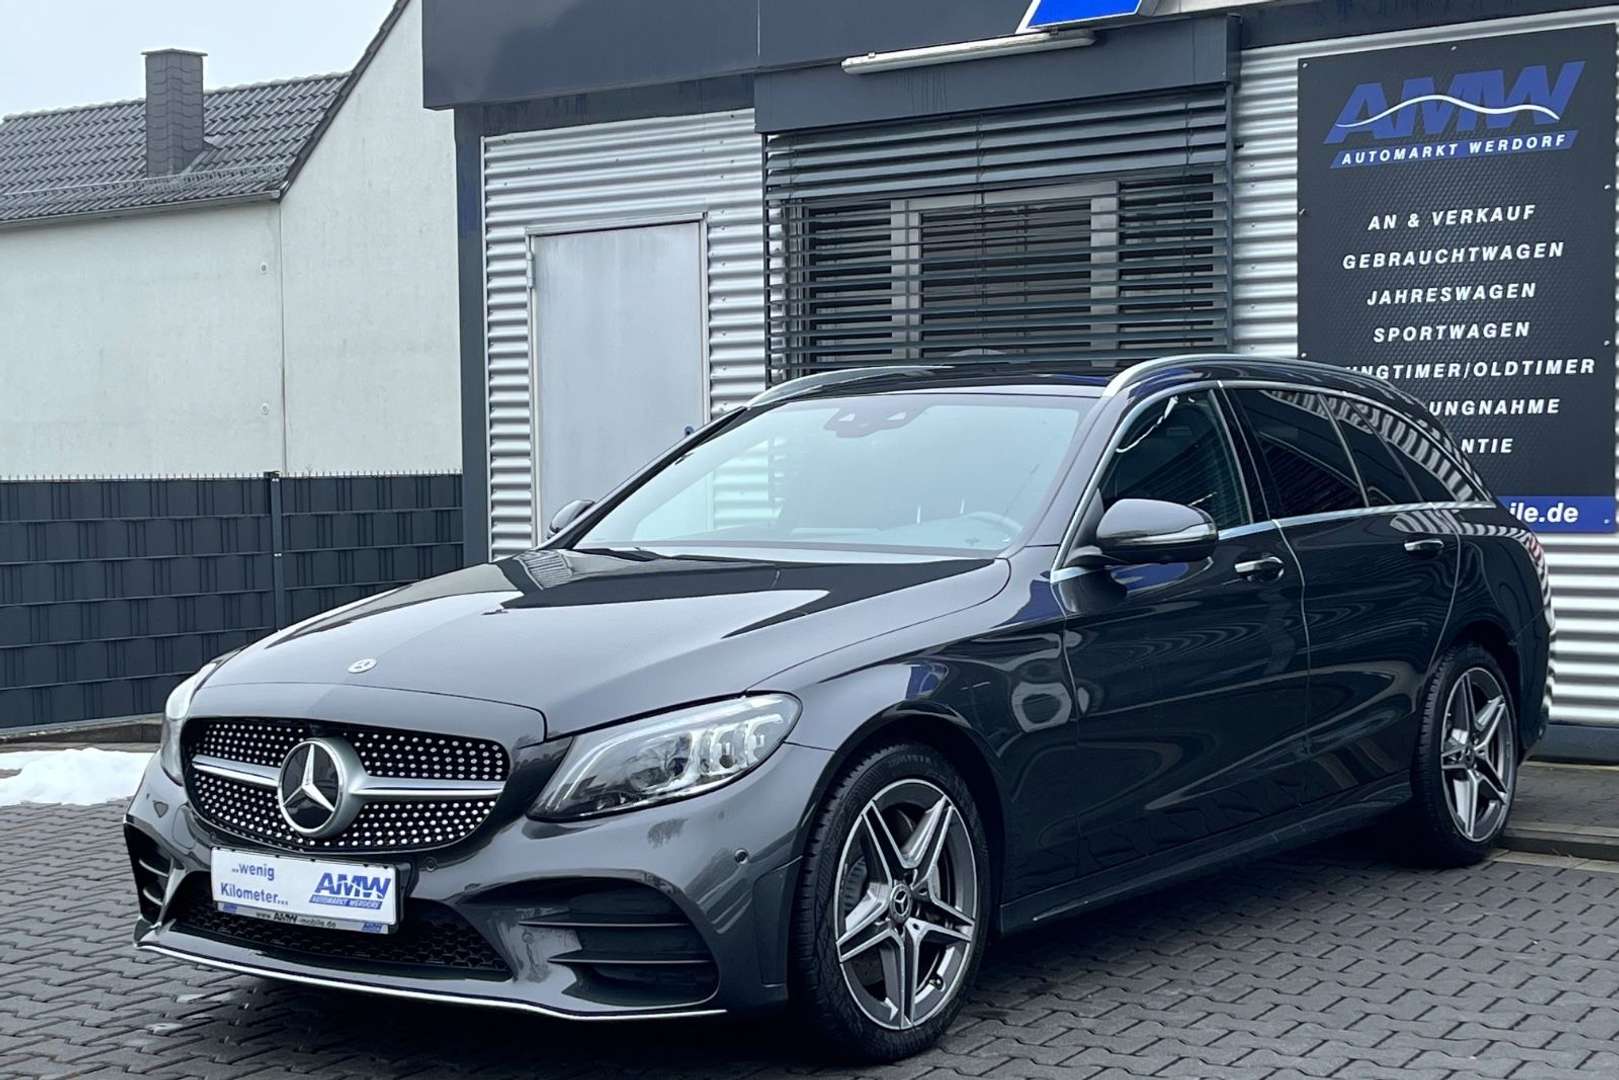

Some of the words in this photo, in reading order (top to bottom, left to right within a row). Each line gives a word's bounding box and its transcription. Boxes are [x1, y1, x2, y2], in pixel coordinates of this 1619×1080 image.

[1323, 60, 1586, 144] AMW
[1341, 143, 1458, 165] AUTOMARKT
[1469, 133, 1567, 154] WERDORF
[1367, 213, 1397, 231] AN
[1407, 212, 1420, 228] &
[1432, 204, 1536, 226] VERKAUF
[1342, 241, 1565, 270] GEBRAUCHTWAGEN
[1366, 282, 1536, 306] JAHRESWAGEN
[1373, 321, 1530, 343] SPORTWAGEN
[1428, 398, 1561, 416] UNGNAHME
[1460, 438, 1514, 454] NTIE
[314, 872, 391, 899] AMW
